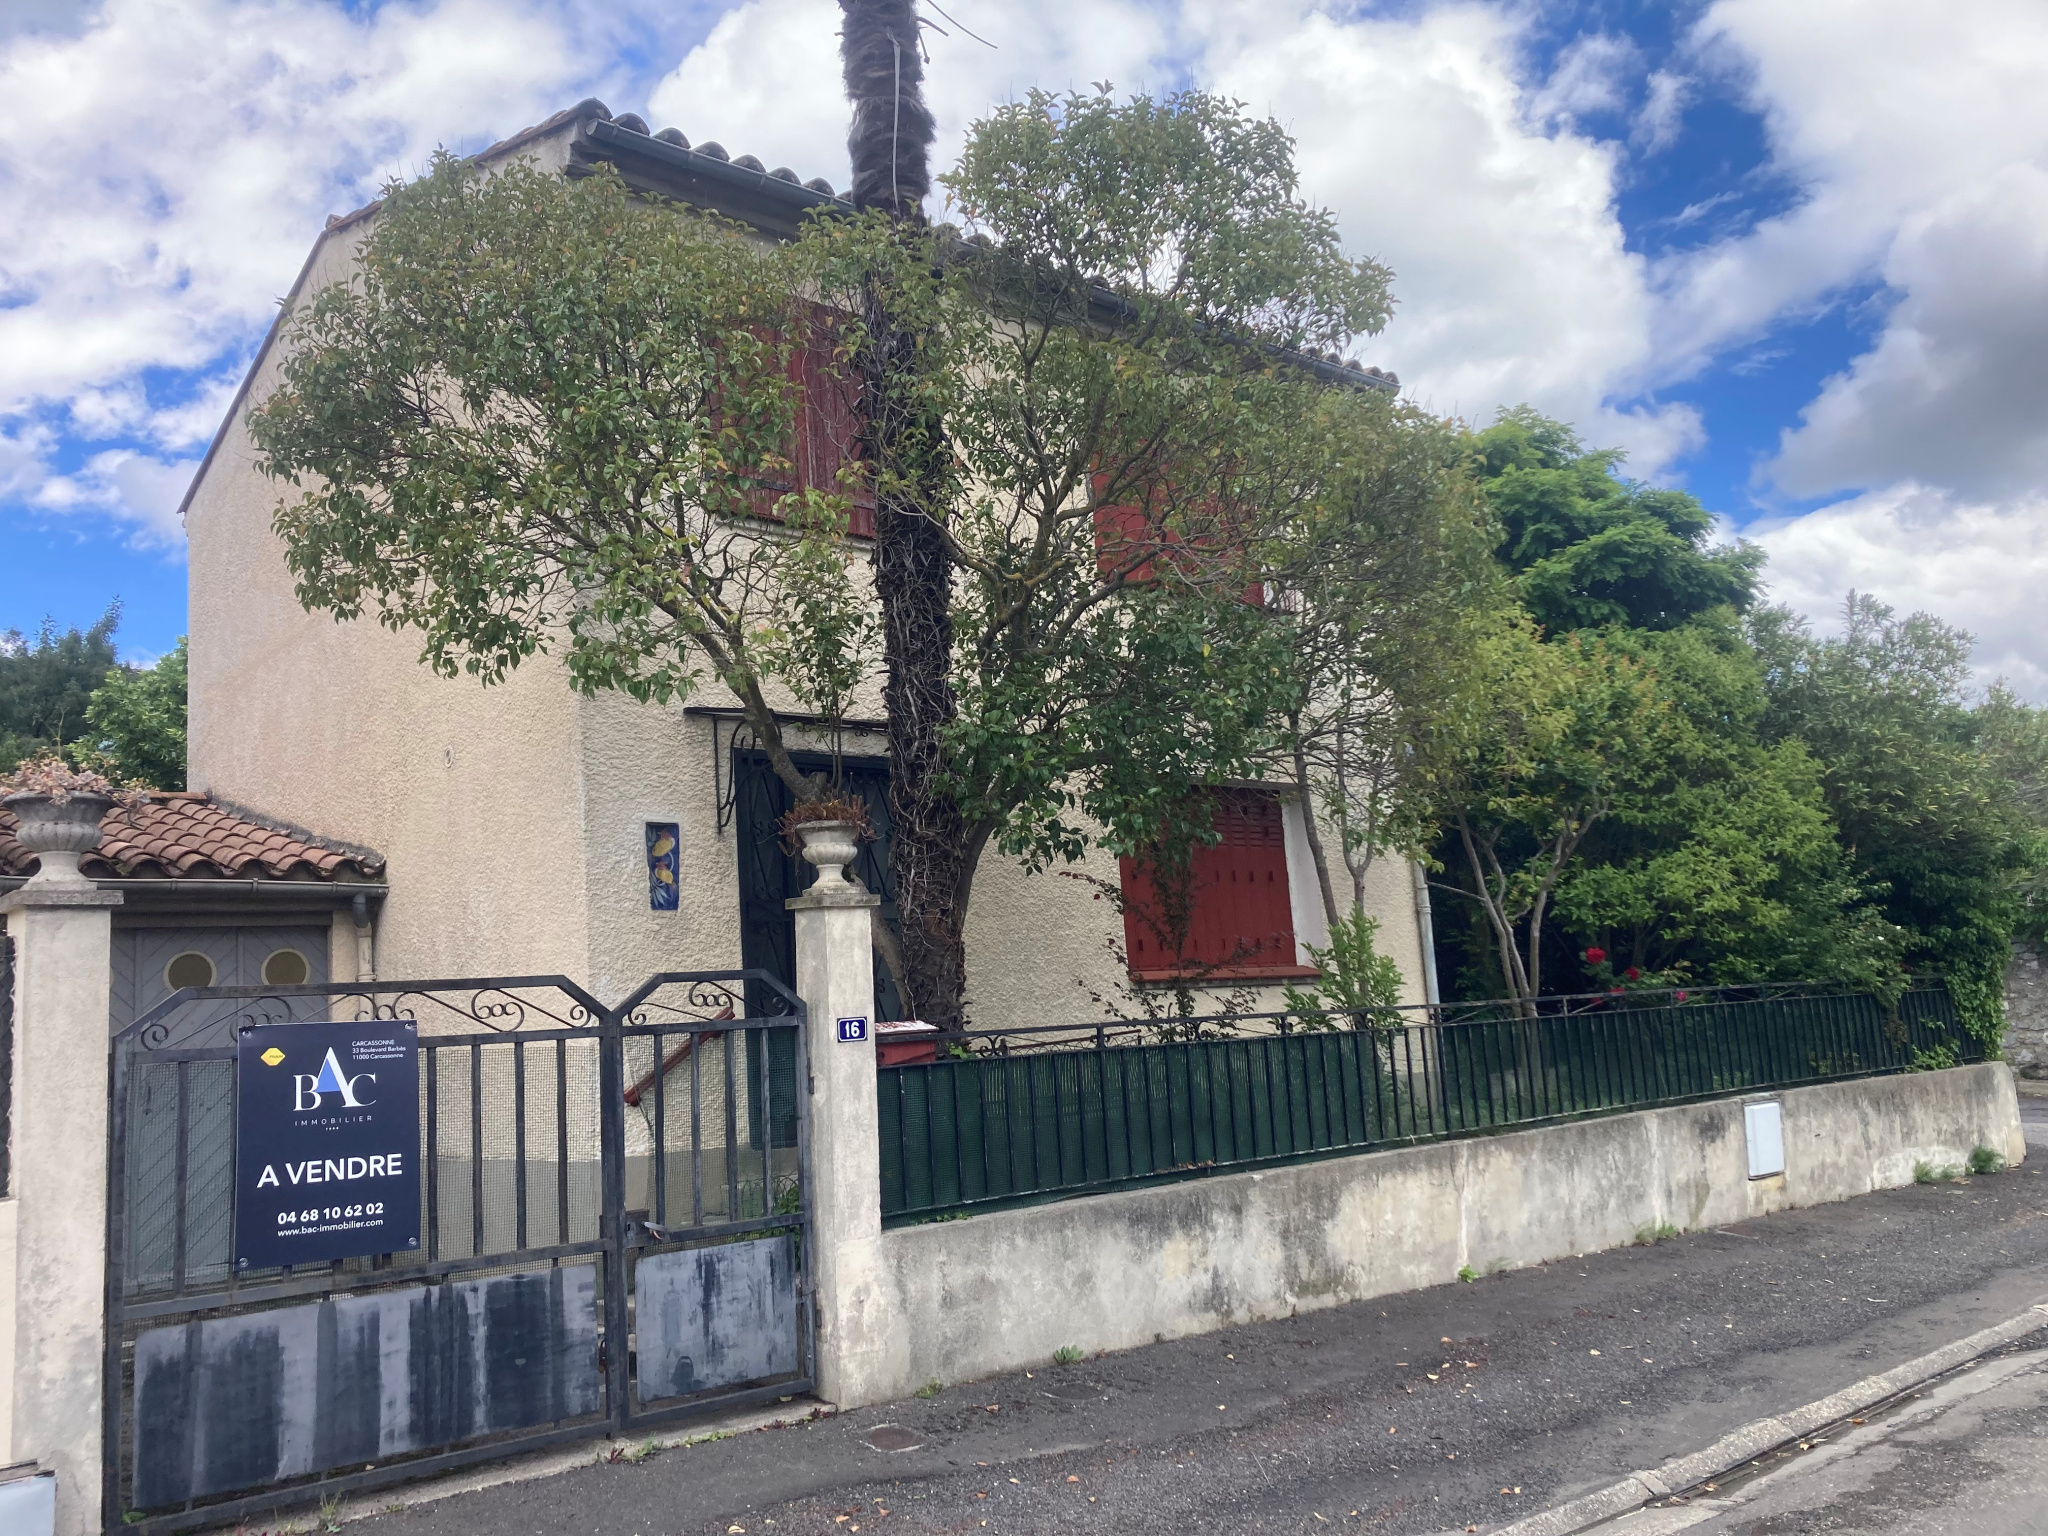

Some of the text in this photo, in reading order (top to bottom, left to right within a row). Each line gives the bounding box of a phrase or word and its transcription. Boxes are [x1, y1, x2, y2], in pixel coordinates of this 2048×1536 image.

[845, 1021, 860, 1038] 16
[293, 1046, 377, 1111] BAC
[295, 1115, 372, 1126] IMMOBILIER
[256, 1153, 403, 1188] A VENDRE
[277, 1202, 384, 1225] 04 68 10 62 02
[277, 1219, 383, 1236] www.bac-immobilier.com
